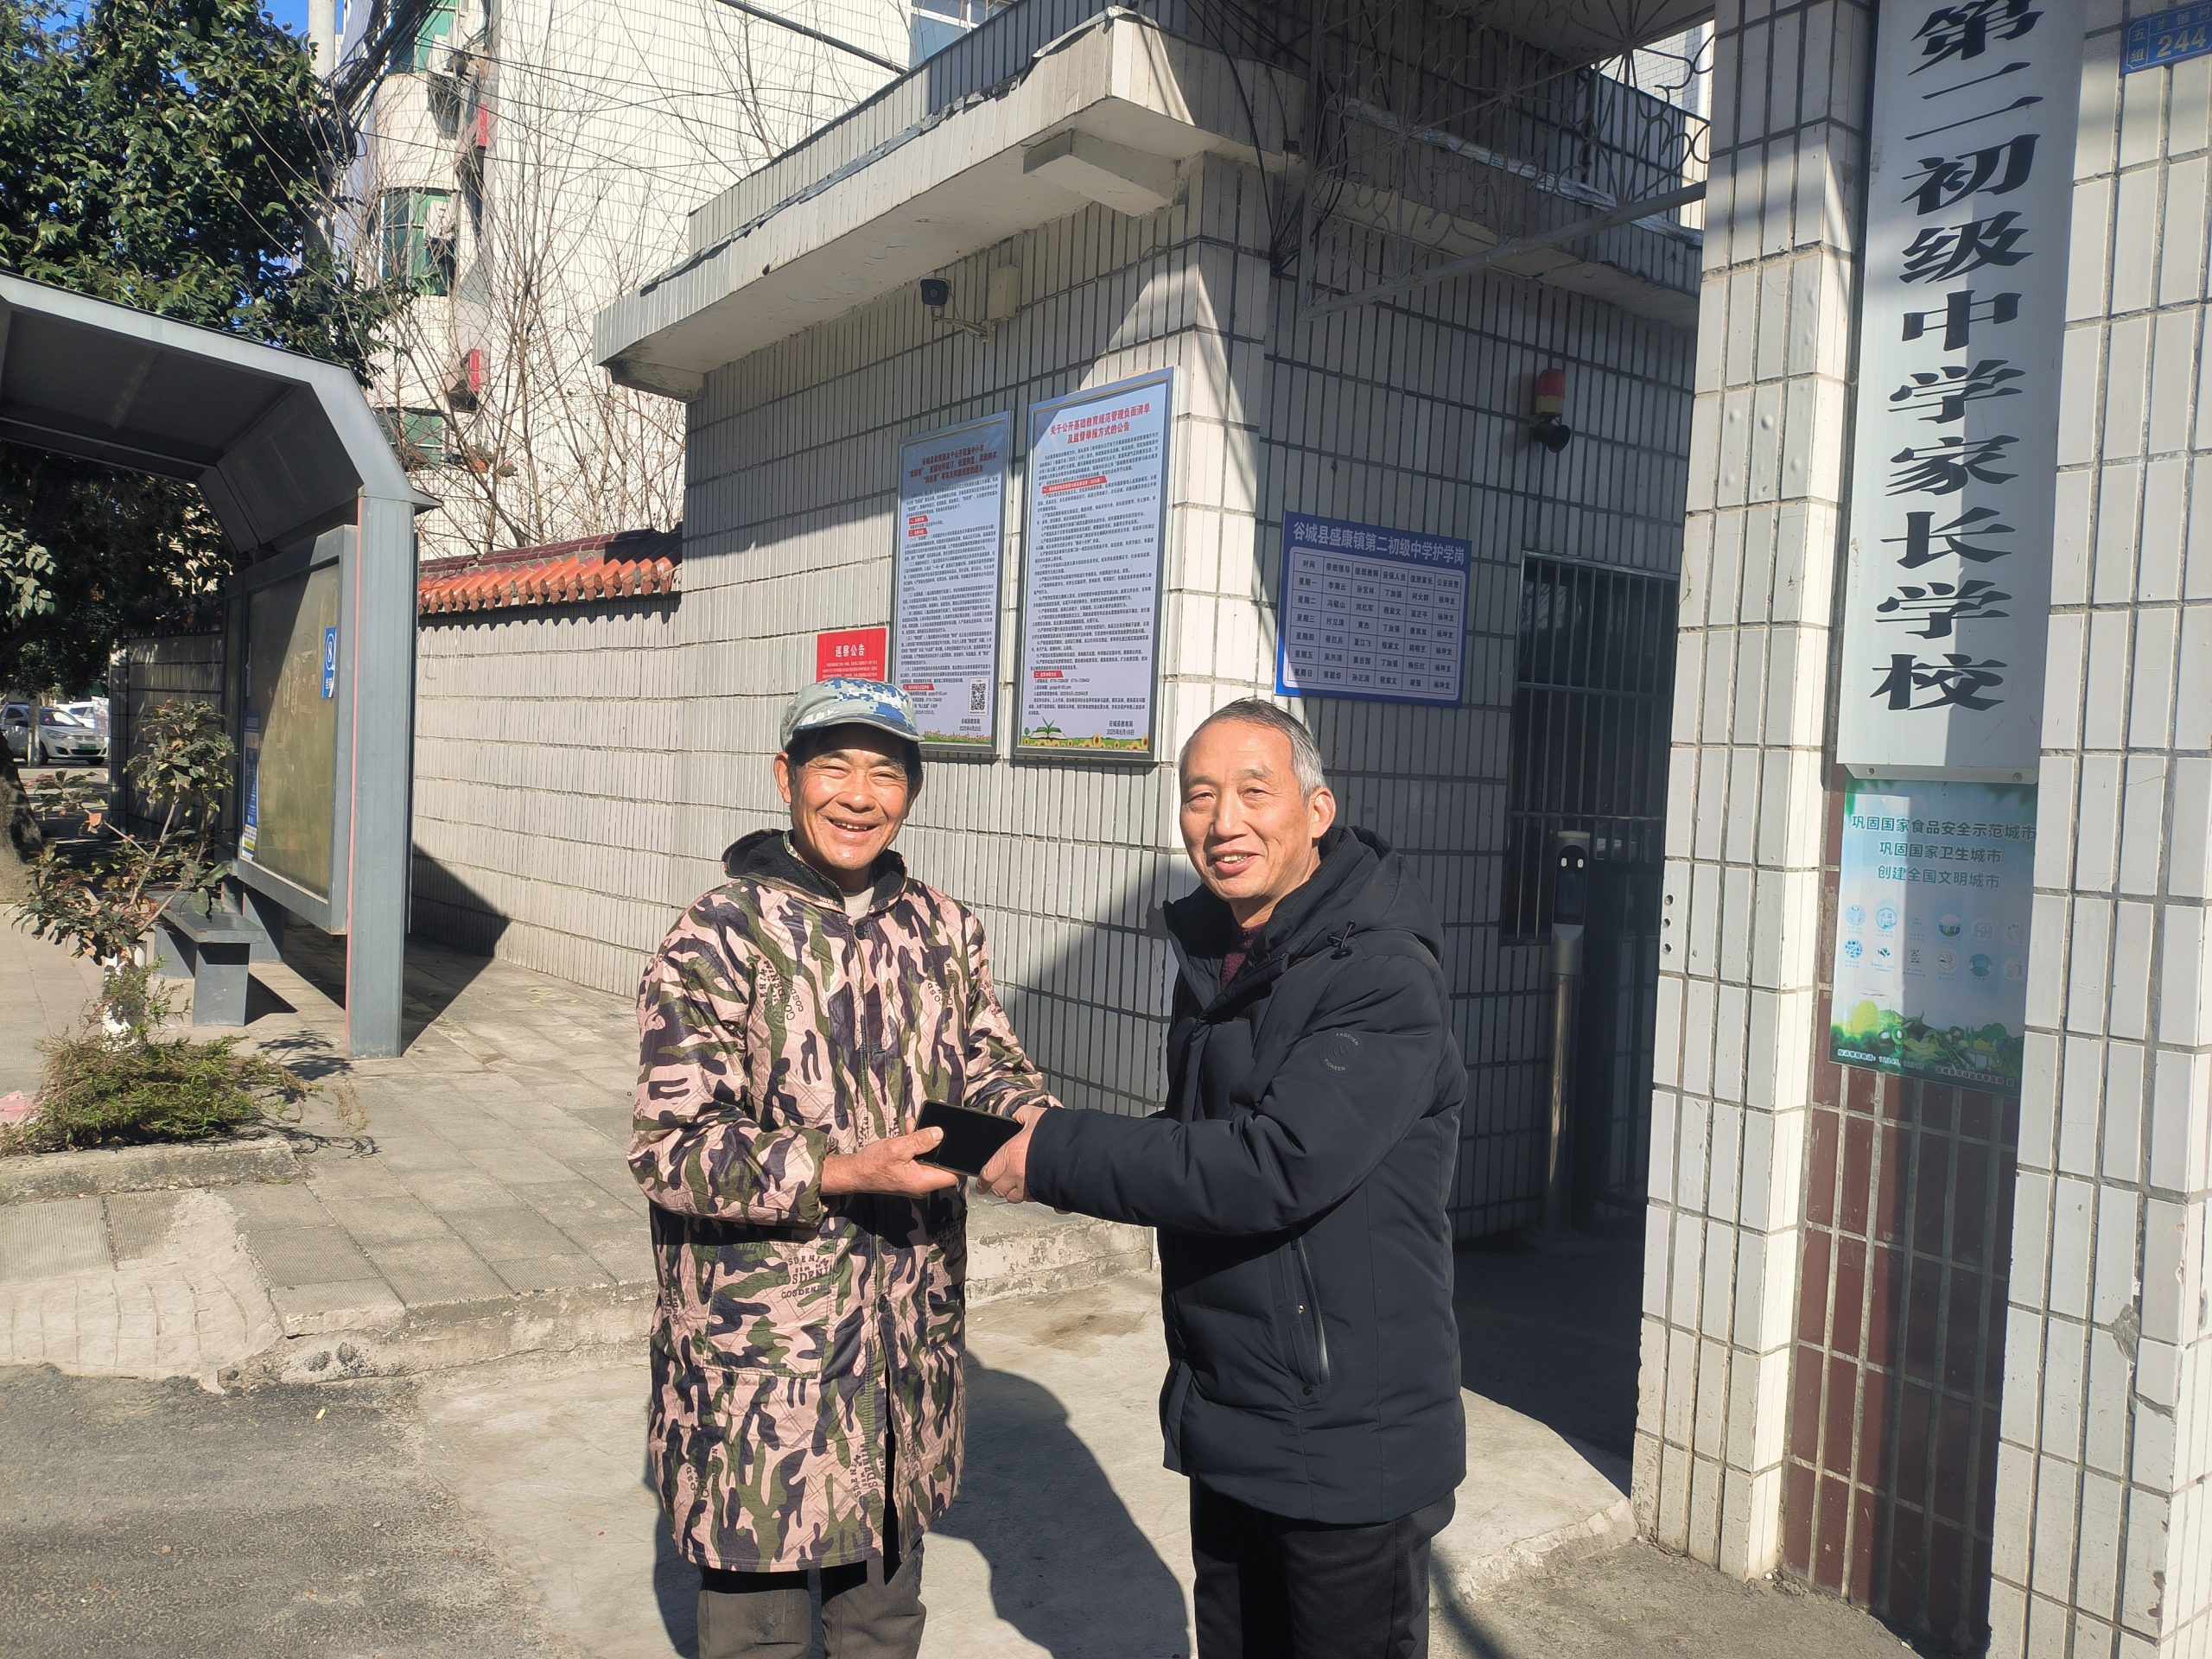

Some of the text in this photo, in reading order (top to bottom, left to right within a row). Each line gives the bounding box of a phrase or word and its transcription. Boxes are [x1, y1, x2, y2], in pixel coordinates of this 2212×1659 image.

[2157, 27, 2207, 58] 244
[1870, 0, 2045, 711] 第二初级中学家长学校
[1294, 521, 1465, 565] 谷城县盛康镇第二初级中学护学岗
[1303, 559, 1315, 569] 时间
[1300, 577, 1317, 587] 星期一
[1298, 594, 1316, 605] 星期二
[1297, 613, 1316, 623] 星期三
[1296, 632, 1314, 641] 星期四
[1295, 650, 1313, 659] 星期五
[1294, 668, 1313, 677] 星期日
[1852, 815, 2037, 841] 巩固国家食品安全示范城市
[1879, 841, 2002, 863] 巩固国家卫生城市
[1878, 865, 2000, 888] 创建全国文明城市
